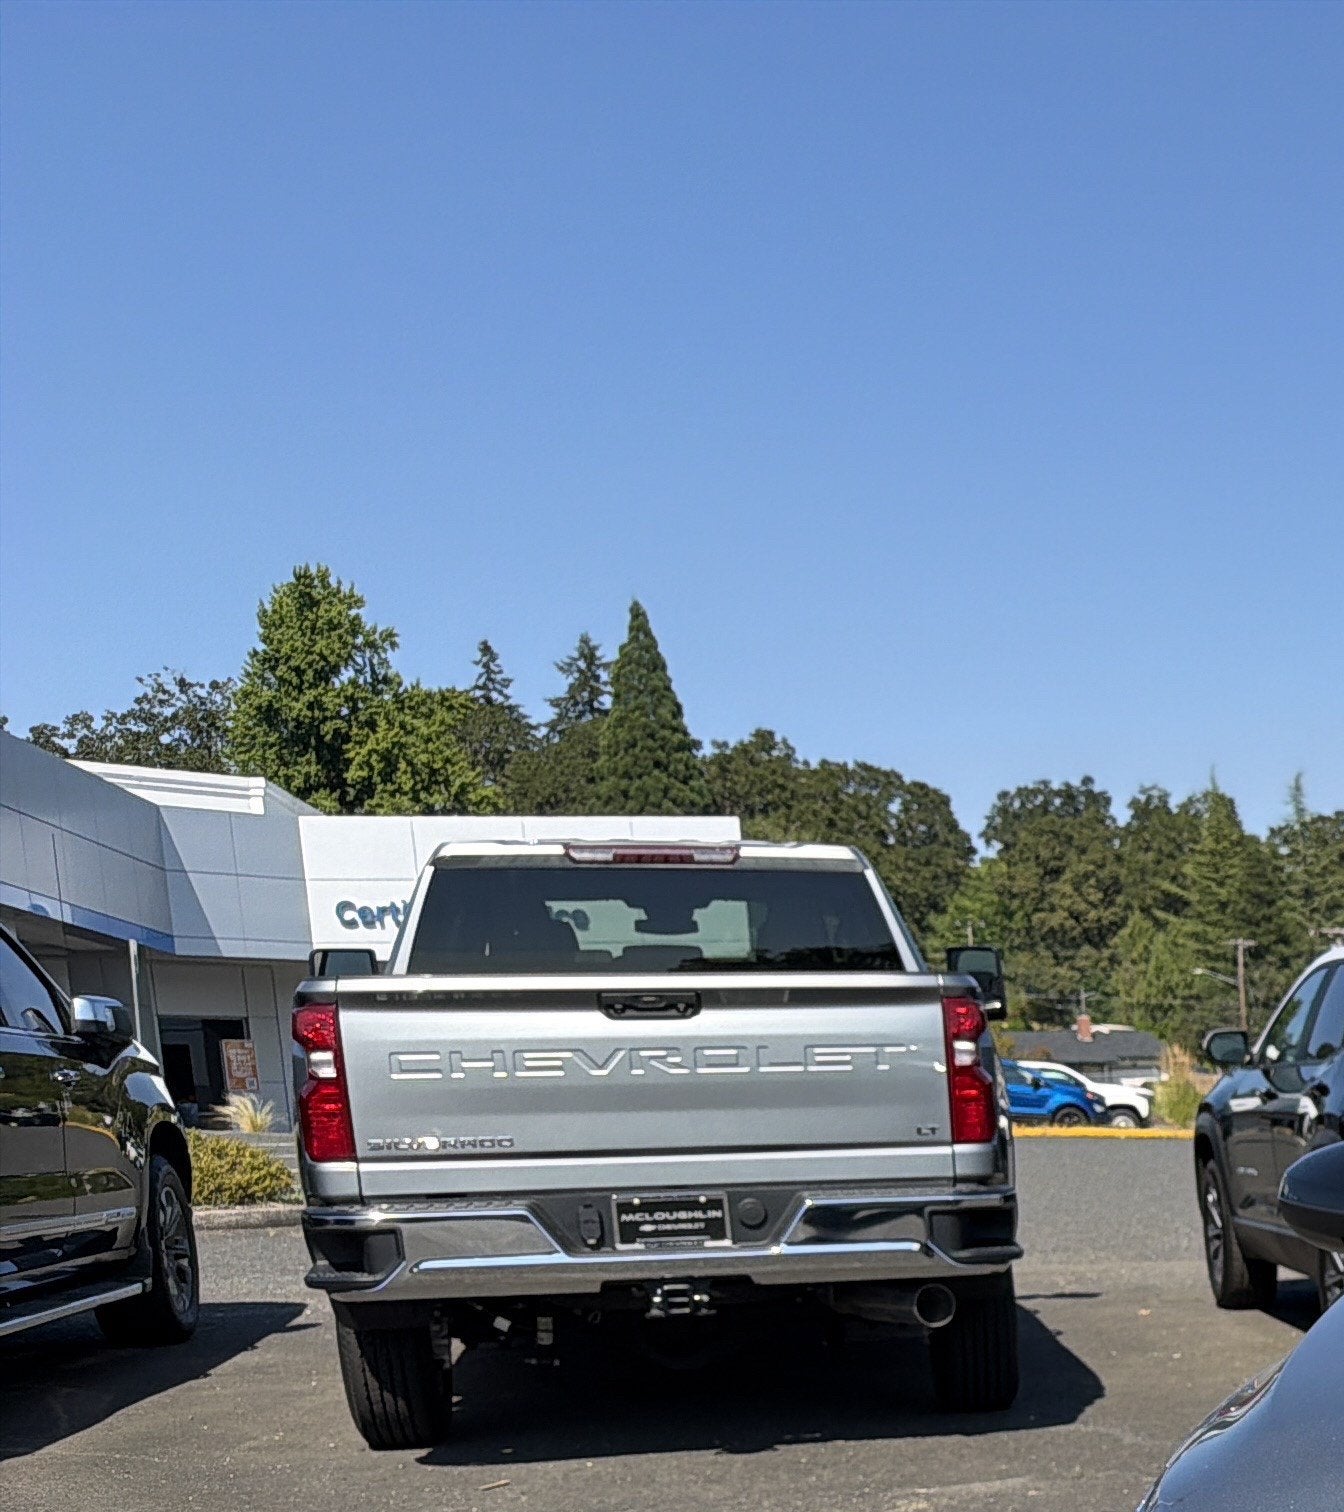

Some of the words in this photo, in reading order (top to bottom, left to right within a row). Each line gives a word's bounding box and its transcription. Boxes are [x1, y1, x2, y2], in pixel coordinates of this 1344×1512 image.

[388, 1043, 907, 1080] CHEVROLET
[916, 1126, 938, 1136] LT
[620, 1209, 723, 1222] MCLOUGHLIN
